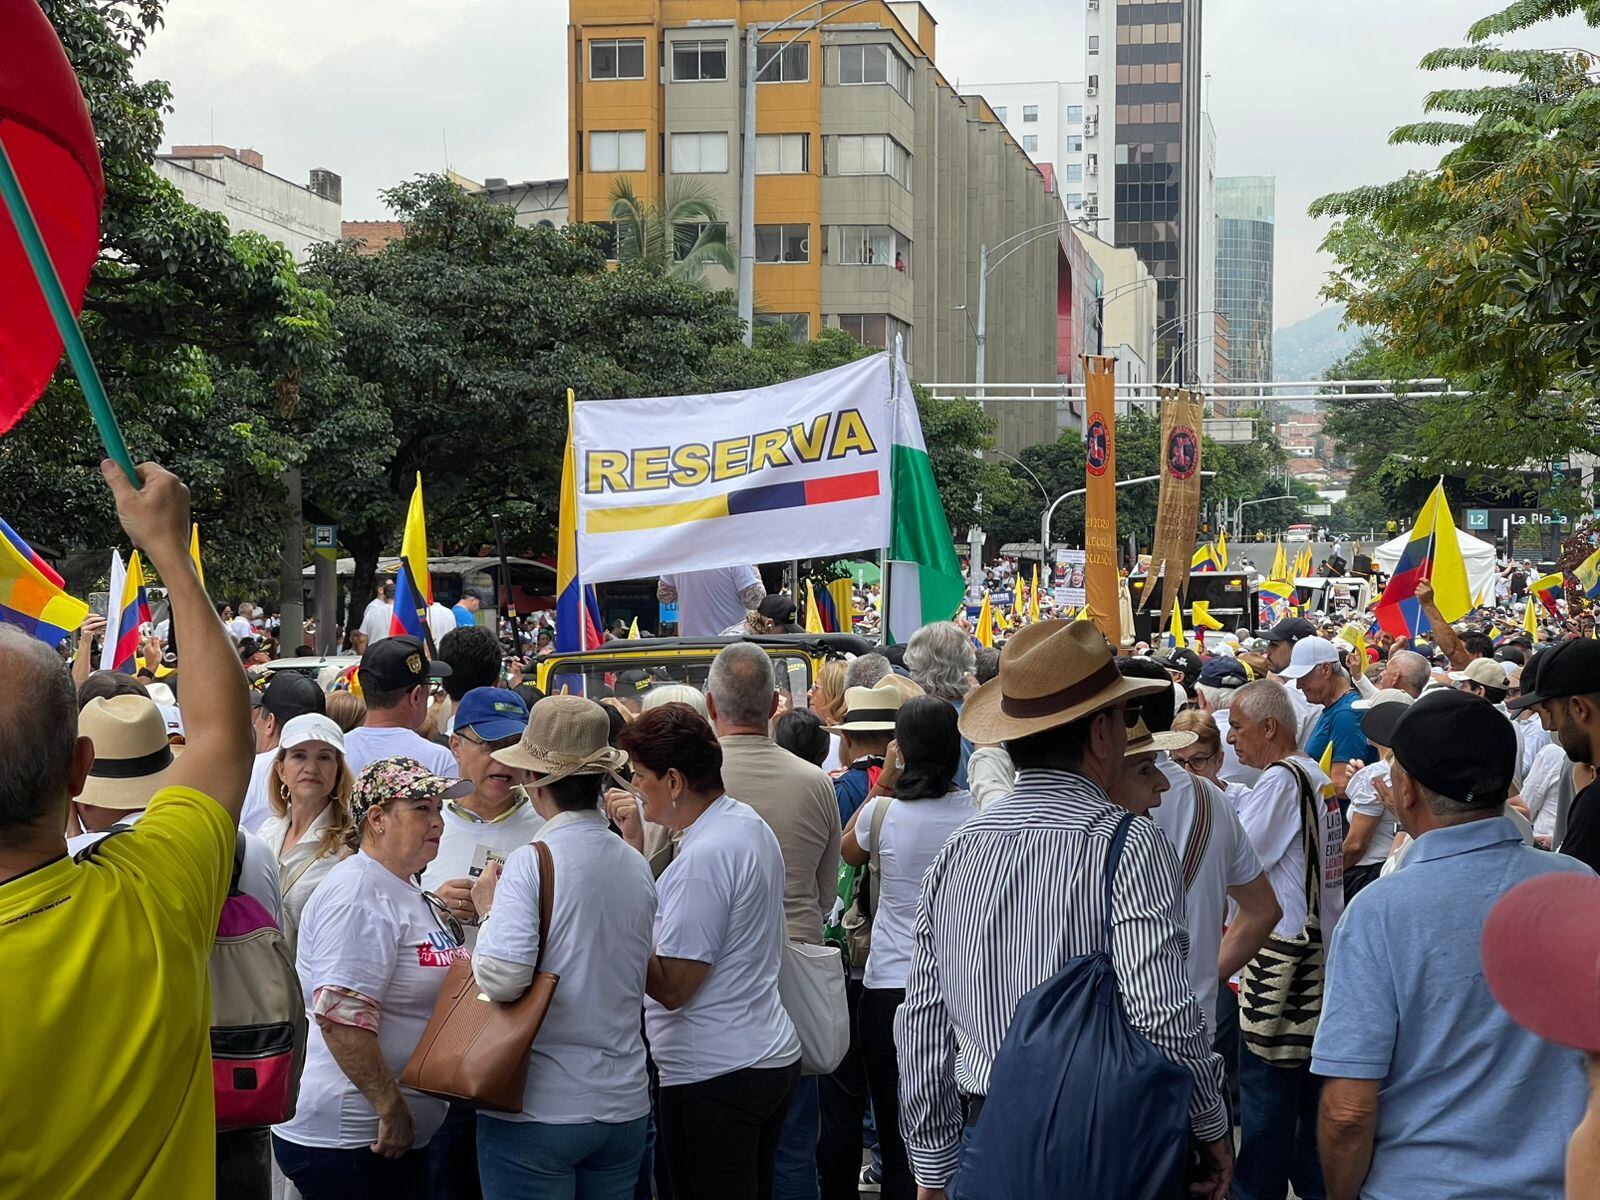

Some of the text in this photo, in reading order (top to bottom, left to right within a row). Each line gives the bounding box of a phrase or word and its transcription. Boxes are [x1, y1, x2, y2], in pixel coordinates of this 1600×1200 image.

[585, 408, 877, 494] RESERVA
[1470, 514, 1484, 525] L2
[1511, 513, 1567, 525] La Plaa
